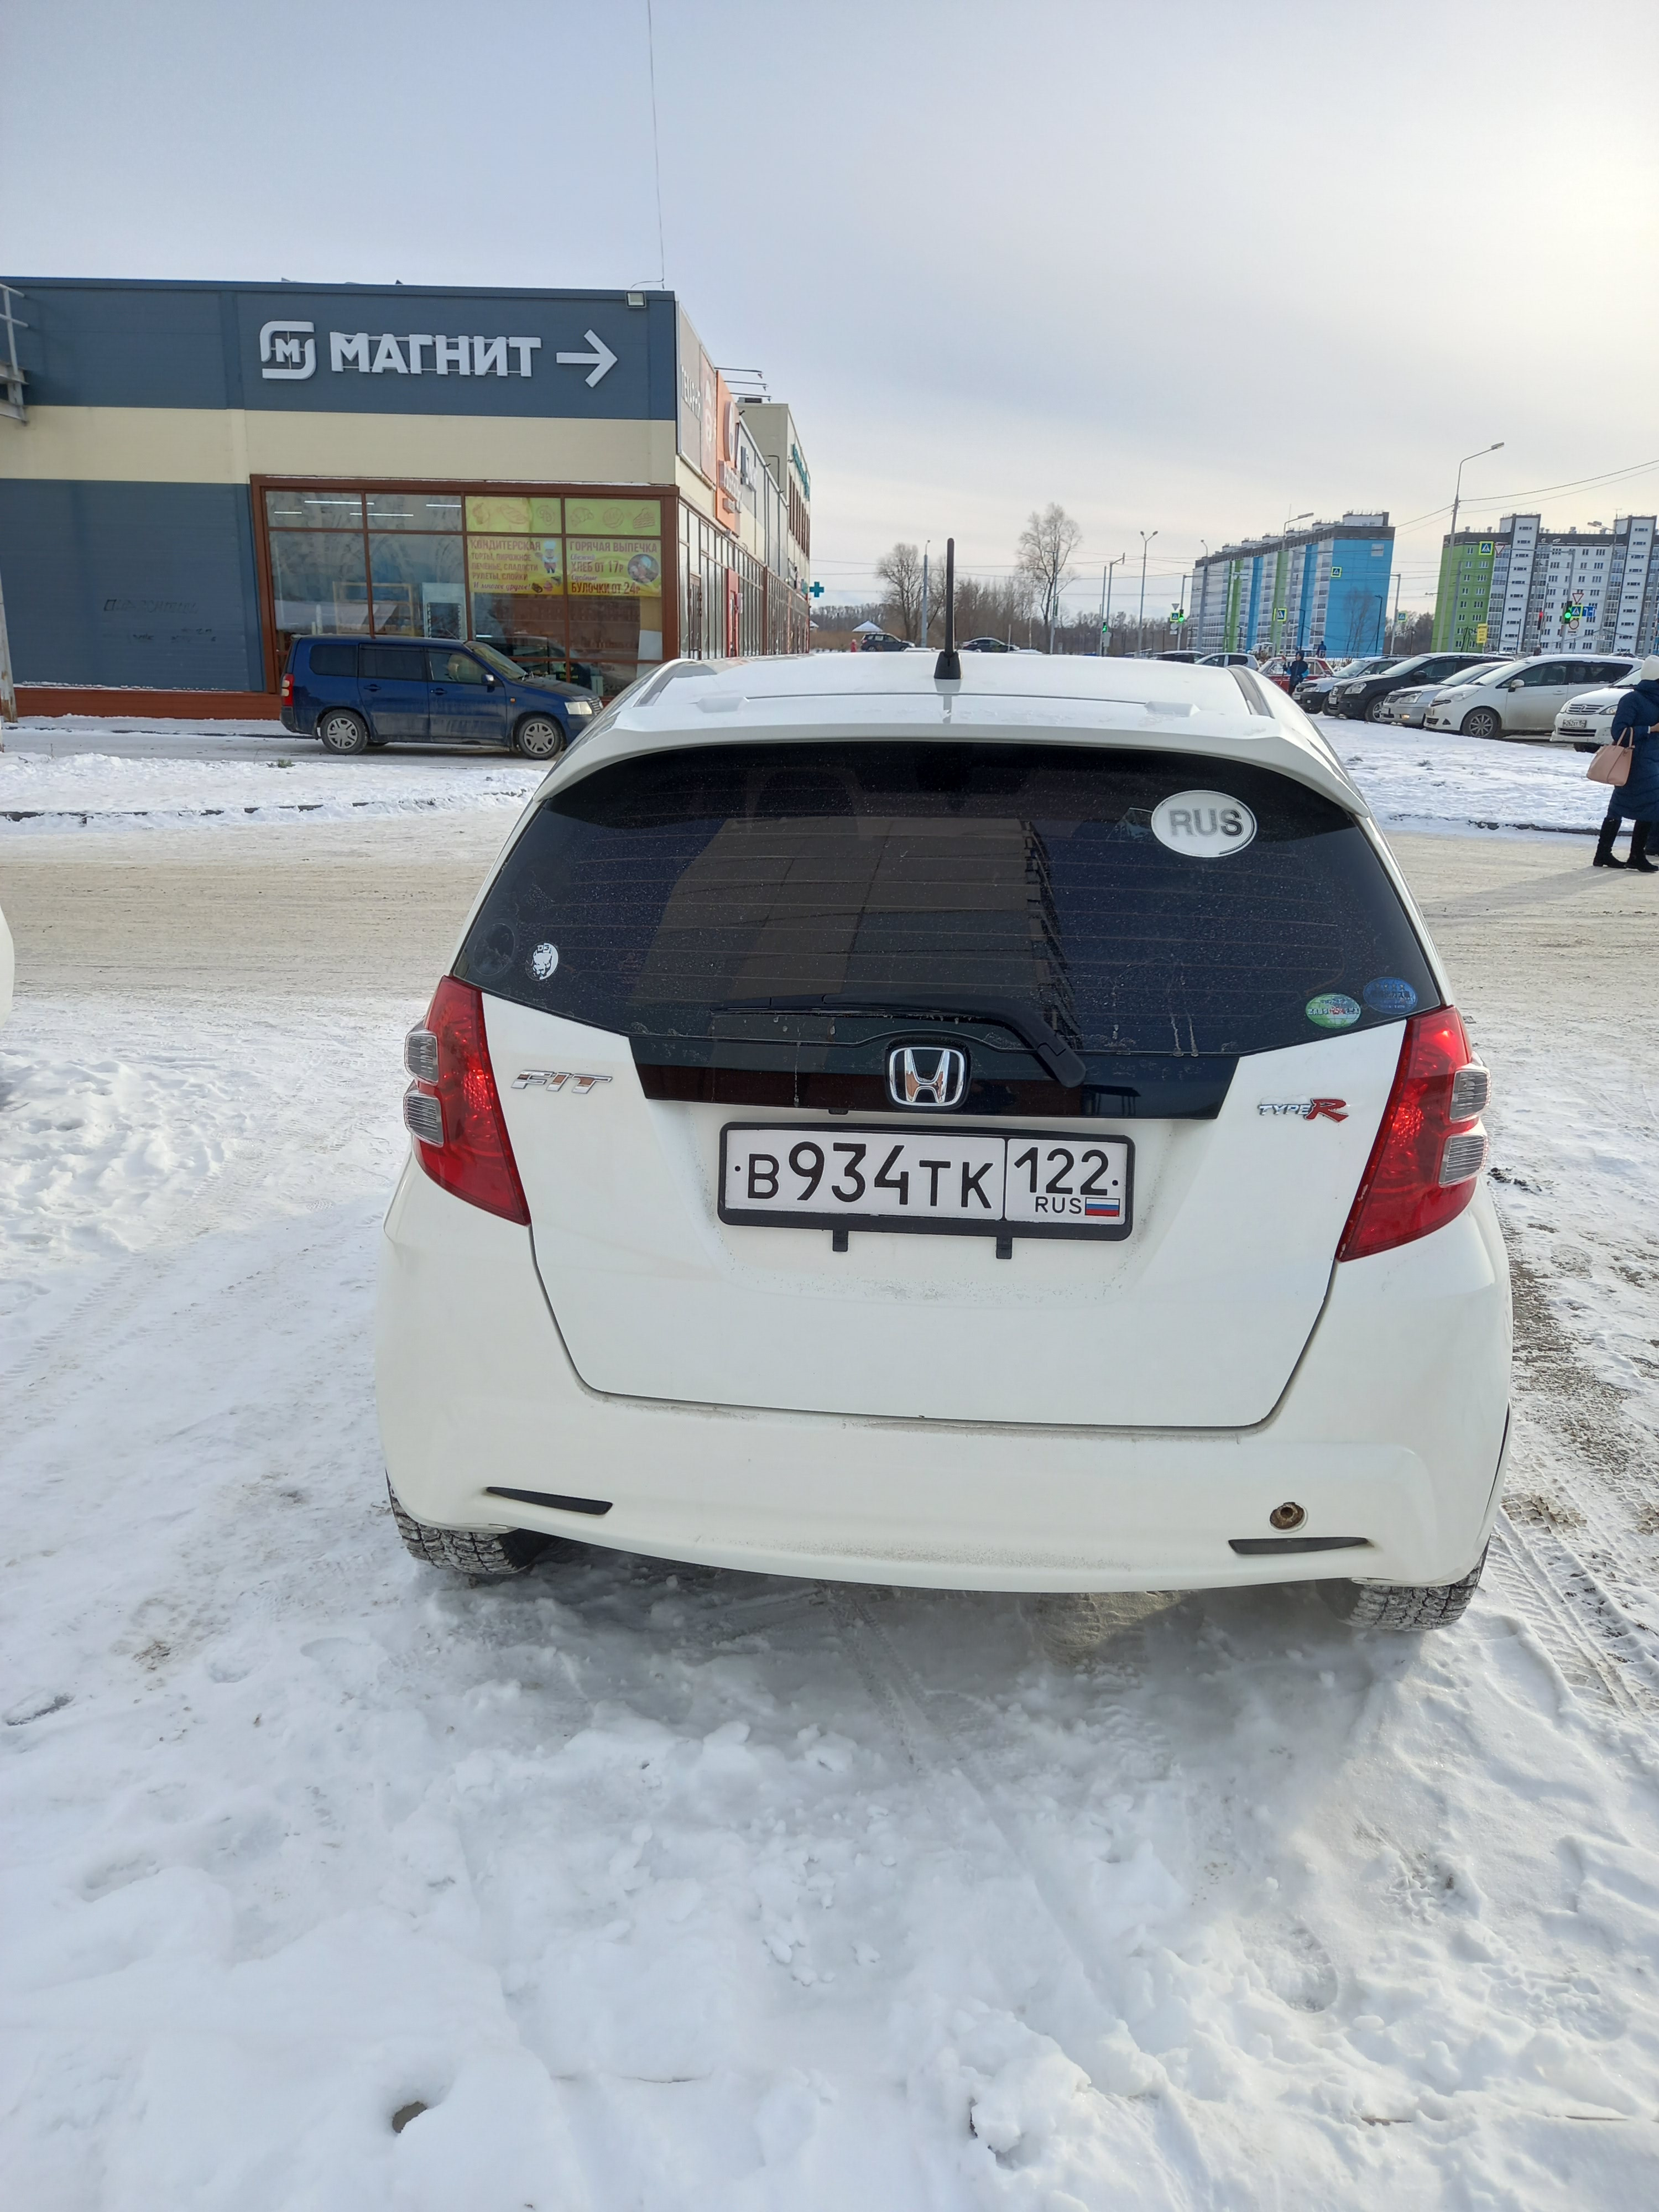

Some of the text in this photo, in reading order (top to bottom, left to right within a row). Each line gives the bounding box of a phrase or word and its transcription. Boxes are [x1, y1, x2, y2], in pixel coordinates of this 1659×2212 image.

[330, 331, 541, 377] МАГНИТ
[471, 540, 540, 551] КОНДИТЕРСКАЯ
[570, 541, 657, 552] ГОРЯЧАЯ ВЫПЕЧКА
[571, 561, 592, 572] ХЛЕБ
[595, 562, 604, 572] ОТ
[502, 572, 528, 581] СЛОЙКИ
[572, 582, 611, 594] БУЛОЧКИ
[612, 583, 622, 594] ОТ
[1168, 807, 1244, 837] RUS
[511, 1069, 612, 1094] FIT
[748, 1141, 1109, 1209] В934ТК 122
[1035, 1196, 1083, 1215] RUS
